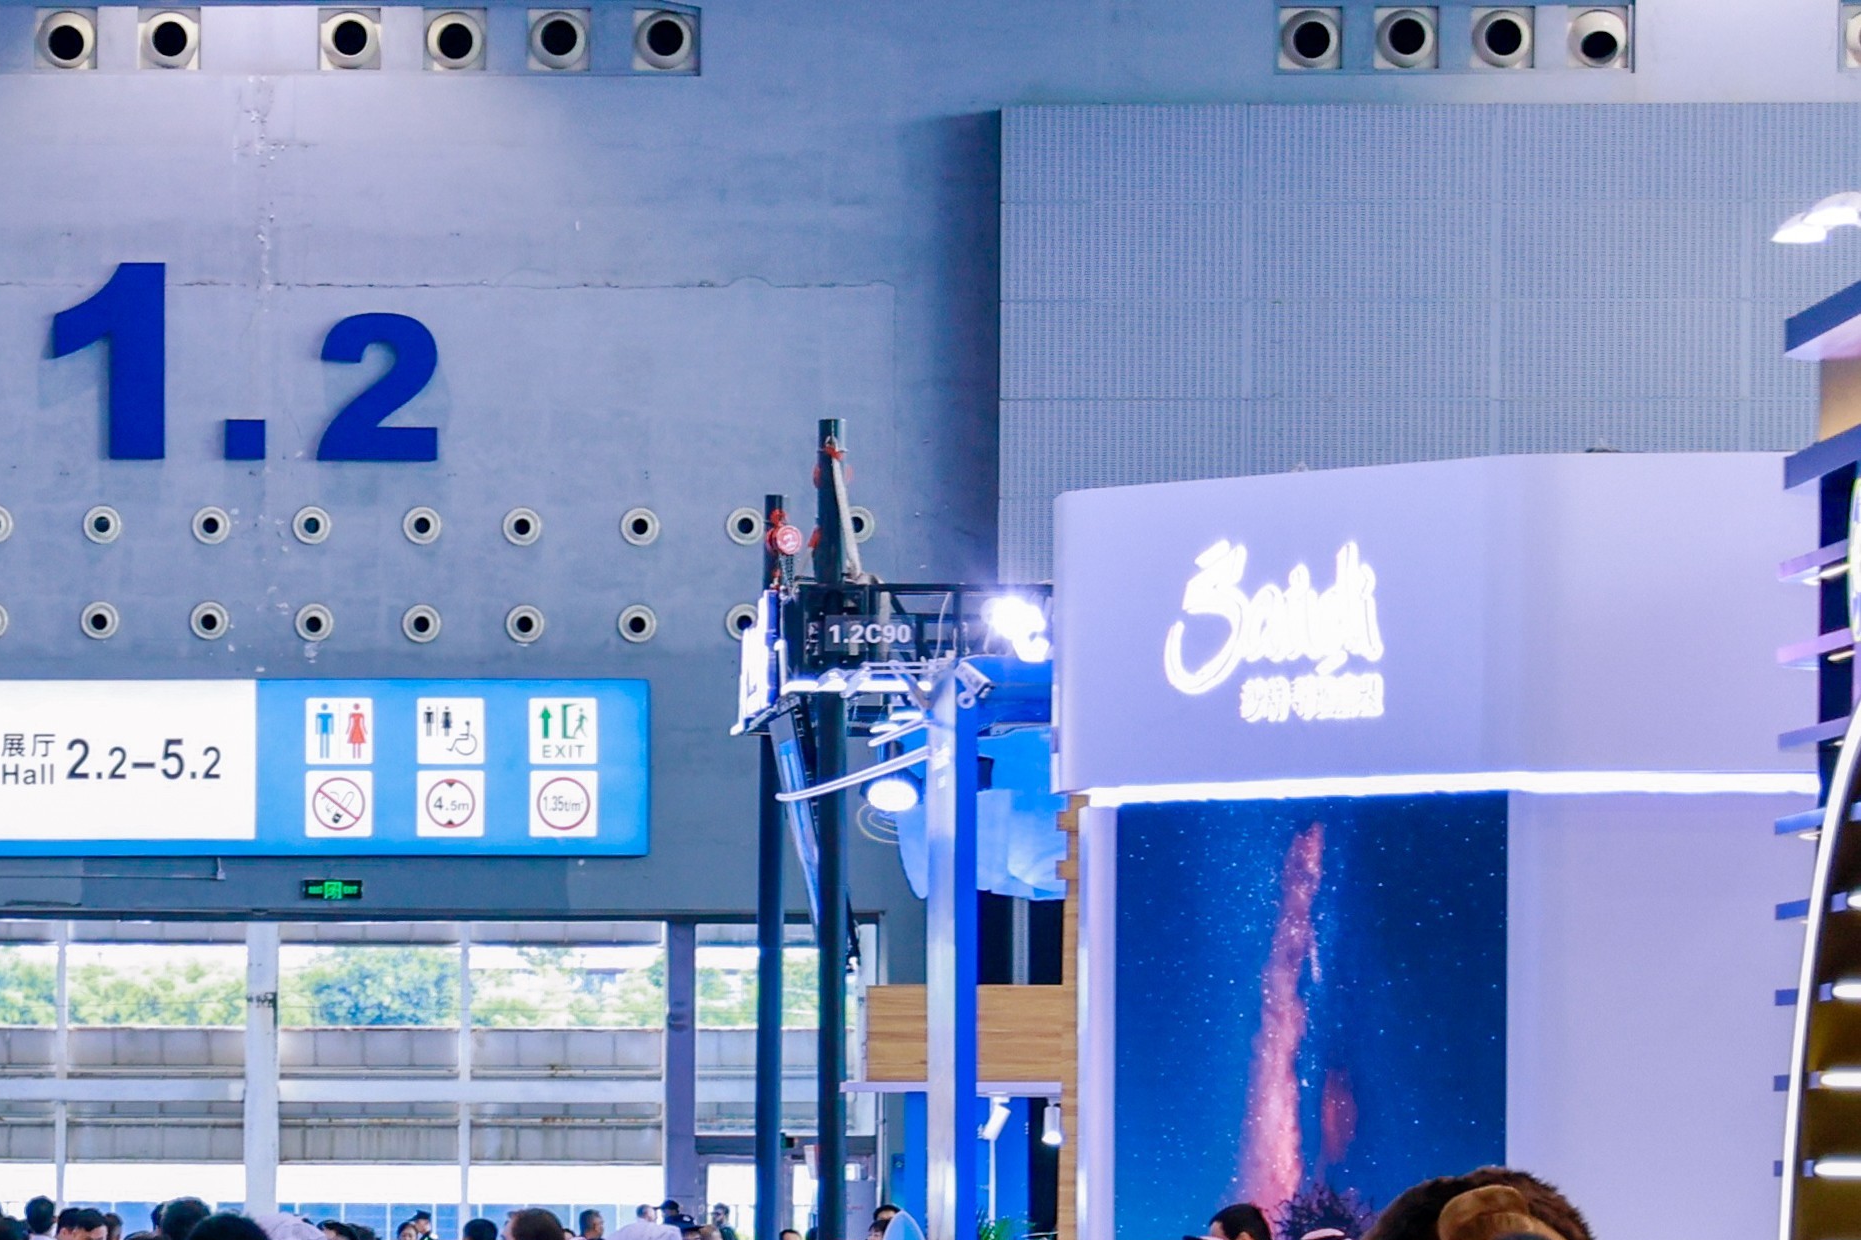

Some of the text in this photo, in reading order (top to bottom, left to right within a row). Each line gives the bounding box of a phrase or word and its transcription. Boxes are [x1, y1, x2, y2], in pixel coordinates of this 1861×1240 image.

[51, 262, 438, 461] 1.2
[828, 623, 912, 644] 1.2C90
[1, 733, 56, 758] 展厅
[541, 744, 586, 758] EXIT
[2, 763, 55, 785] Hall
[433, 796, 470, 812] 4.5m
